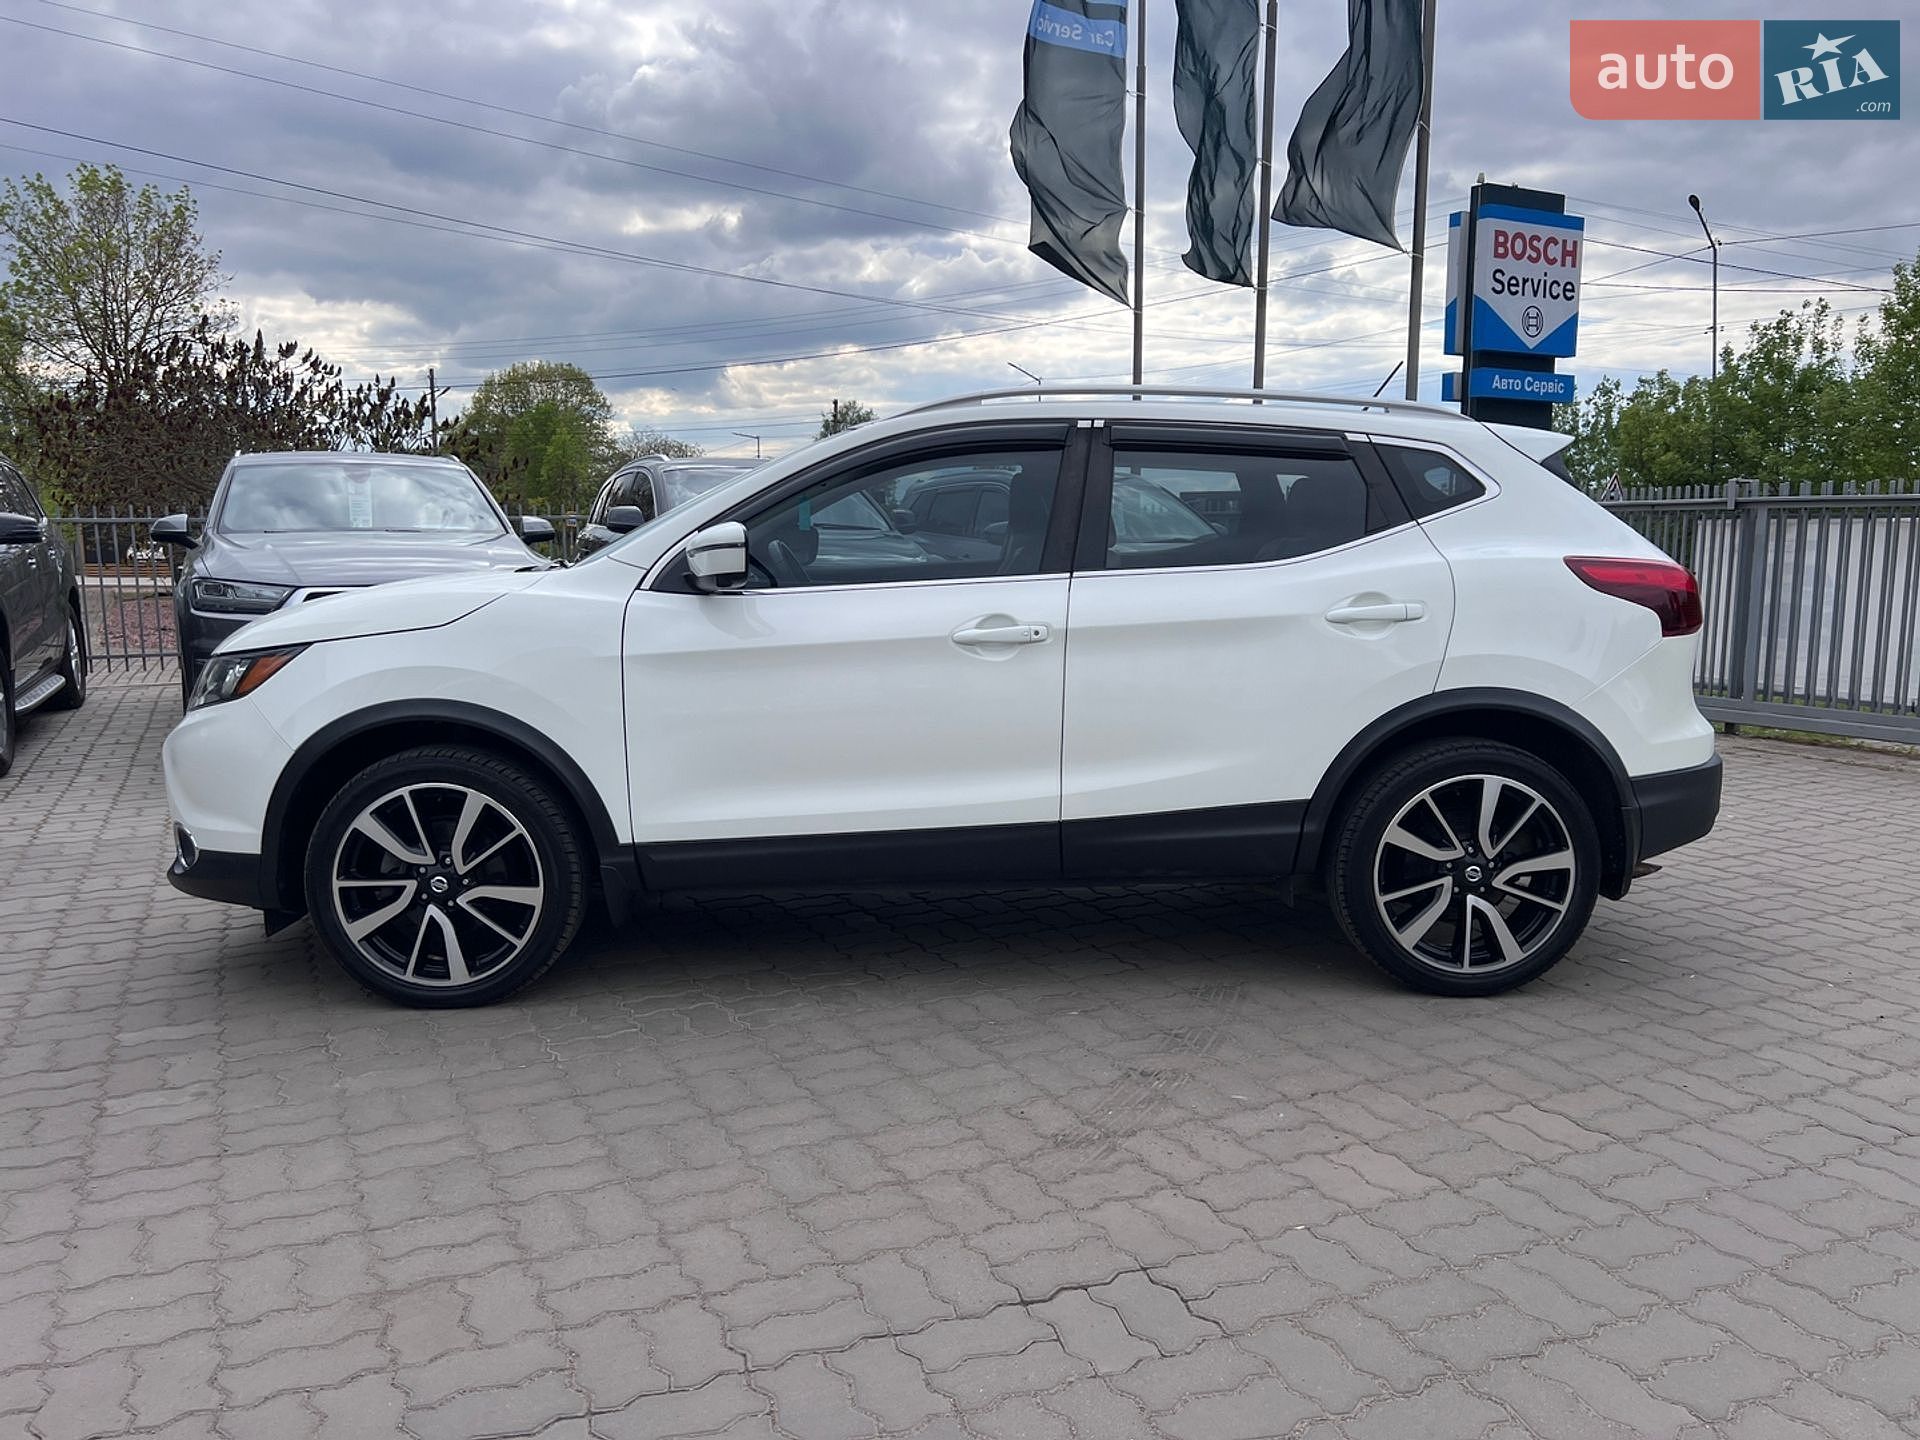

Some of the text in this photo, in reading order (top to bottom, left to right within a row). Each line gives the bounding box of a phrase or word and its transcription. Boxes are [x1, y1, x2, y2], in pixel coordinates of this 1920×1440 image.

[1493, 229, 1578, 268] BOSCH
[1491, 268, 1576, 301] Service
[1492, 374, 1565, 396] Авто Сервіс
